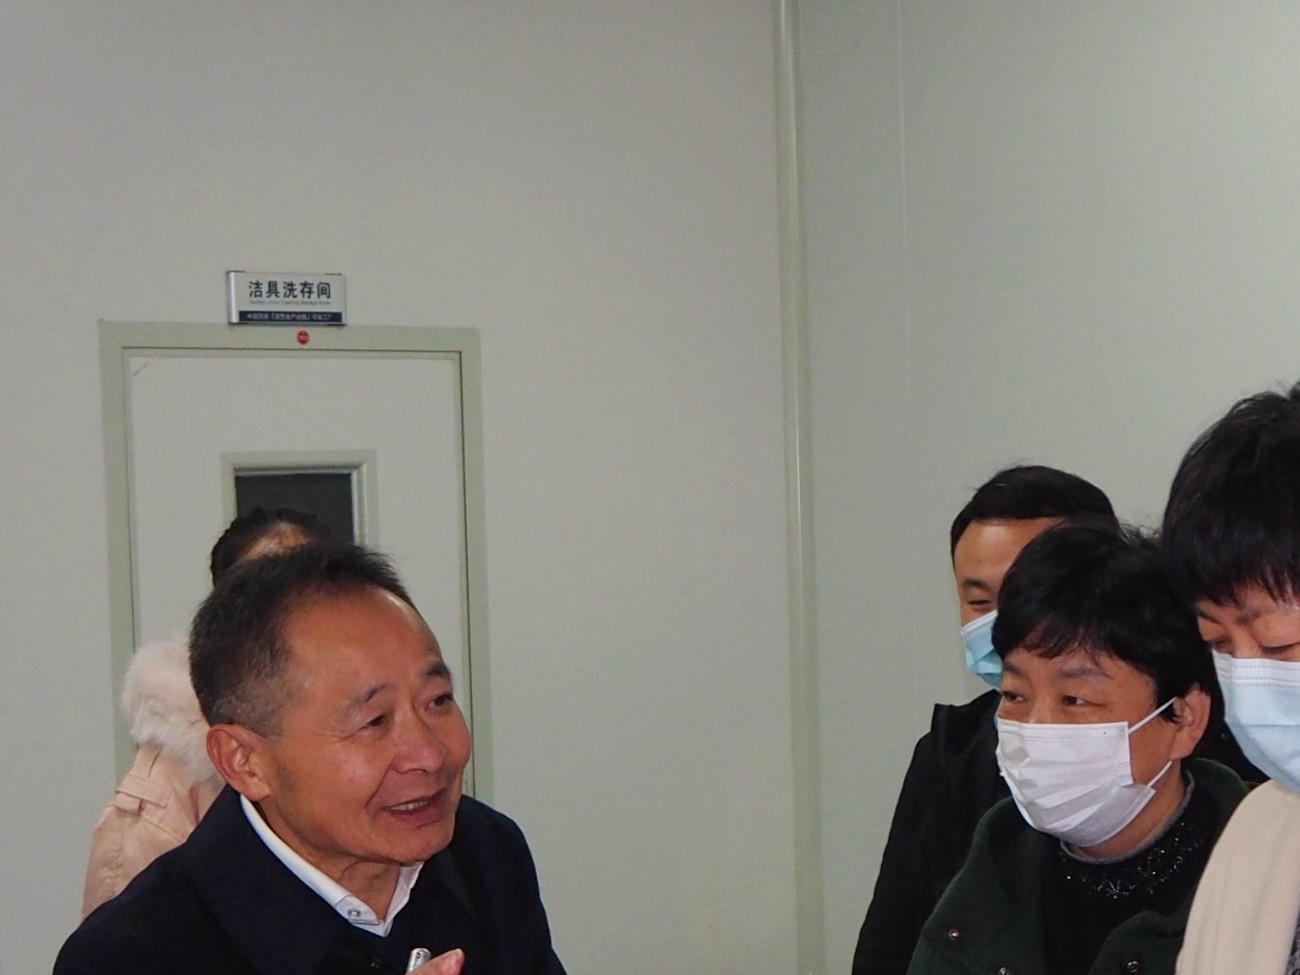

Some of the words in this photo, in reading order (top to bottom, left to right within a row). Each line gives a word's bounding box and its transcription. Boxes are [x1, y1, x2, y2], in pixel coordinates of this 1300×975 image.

[248, 280, 331, 299] 洁具洗存间
